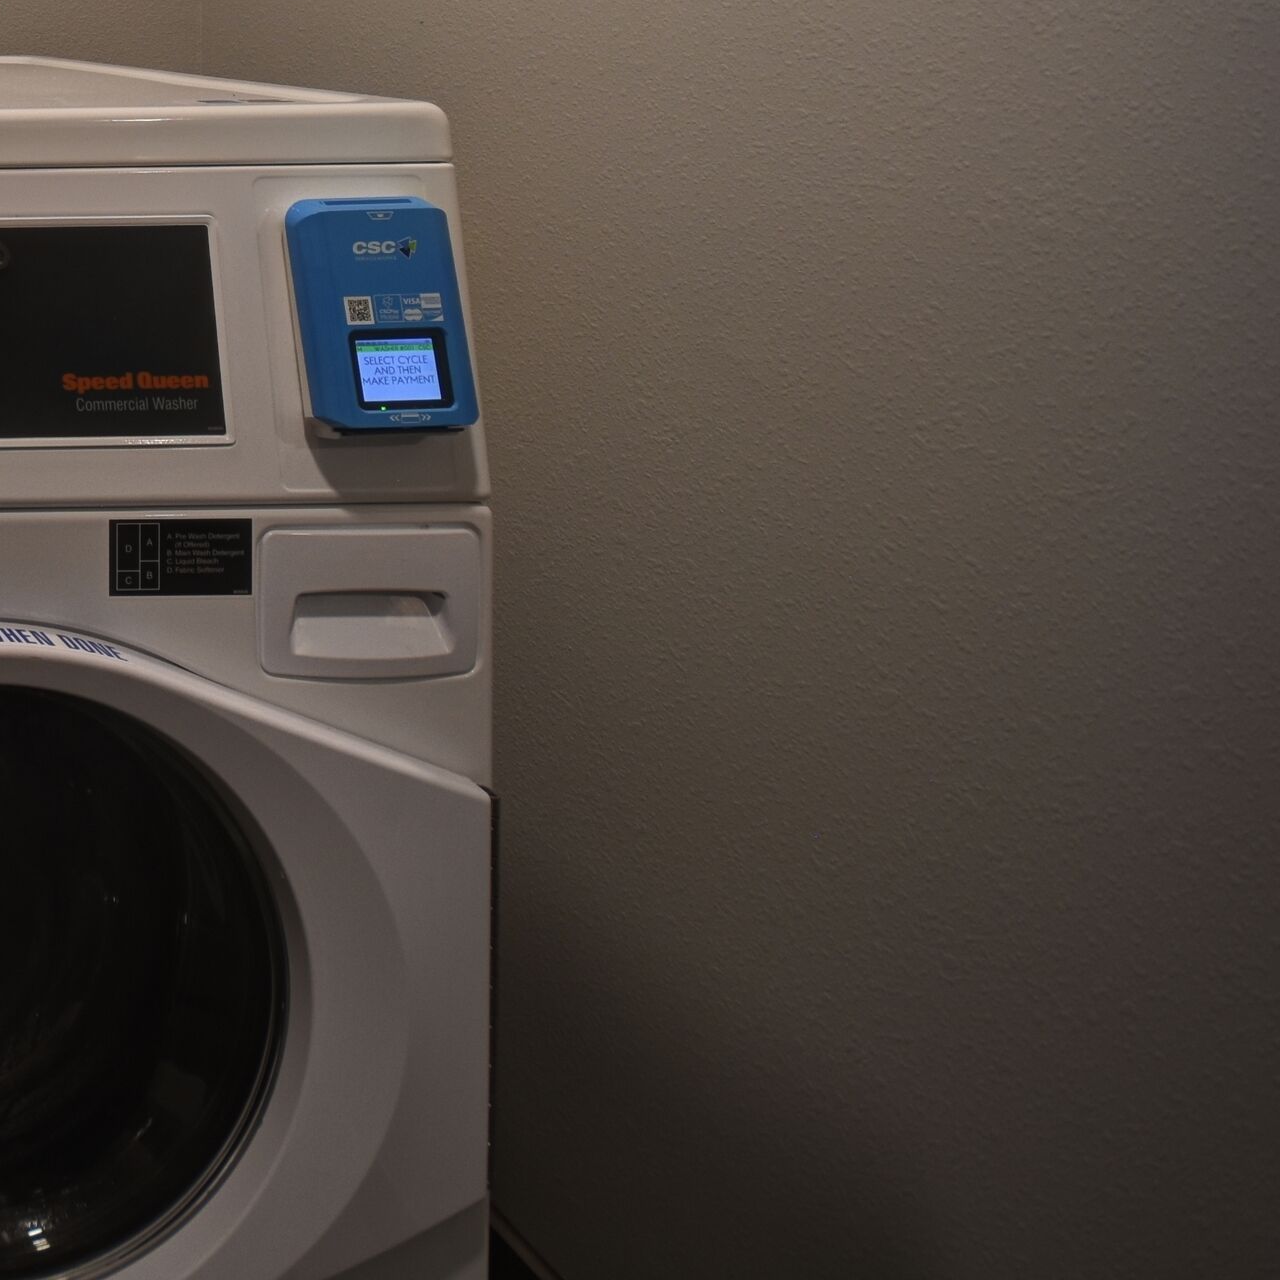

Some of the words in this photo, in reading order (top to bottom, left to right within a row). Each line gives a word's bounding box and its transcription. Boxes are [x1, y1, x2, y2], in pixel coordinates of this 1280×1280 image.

[353, 240, 396, 254] CSC
[403, 297, 421, 305] VISA
[364, 356, 395, 366] SELECT
[398, 355, 428, 365] CYCLE
[374, 366, 395, 375] AND
[398, 365, 421, 374] THEN
[62, 371, 133, 394] Speed
[137, 370, 209, 389] Queen
[363, 376, 389, 385] MAKE
[392, 374, 435, 384] PAYMENT
[76, 396, 149, 412] Commercial
[152, 396, 199, 411] Washer
[146, 538, 153, 546] A
[208, 533, 240, 541] Detergent
[125, 545, 132, 553] D
[212, 549, 244, 558] Detergent
[125, 577, 132, 585] C
[56, 633, 129, 661] DONE
